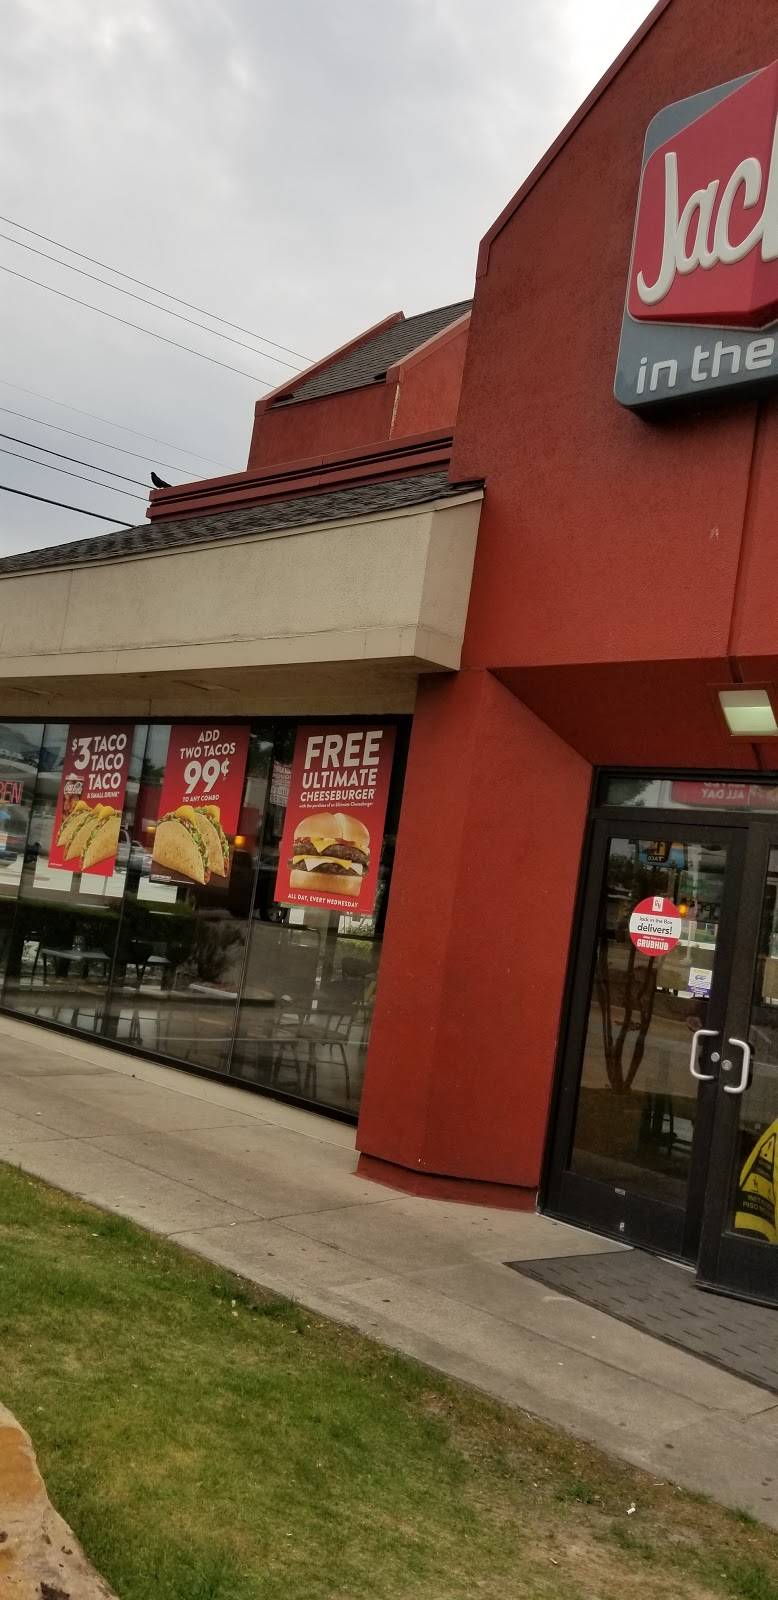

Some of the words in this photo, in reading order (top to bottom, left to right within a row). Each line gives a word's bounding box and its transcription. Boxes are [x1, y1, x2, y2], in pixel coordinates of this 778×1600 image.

[636, 356, 678, 395] in
[691, 337, 775, 383] the
[94, 733, 127, 753] TACO
[197, 729, 220, 743] ADD
[180, 746, 201, 760] TWO
[203, 742, 236, 757] TACOS
[303, 730, 383, 770] FREE
[91, 752, 124, 771] TACO
[88, 772, 121, 791] TACO
[302, 768, 378, 789] ULTIMATE
[300, 788, 375, 802] CHEESEBURGER
[326, 899, 358, 908] WEDNESDAY
[637, 923, 673, 935] delivers!
